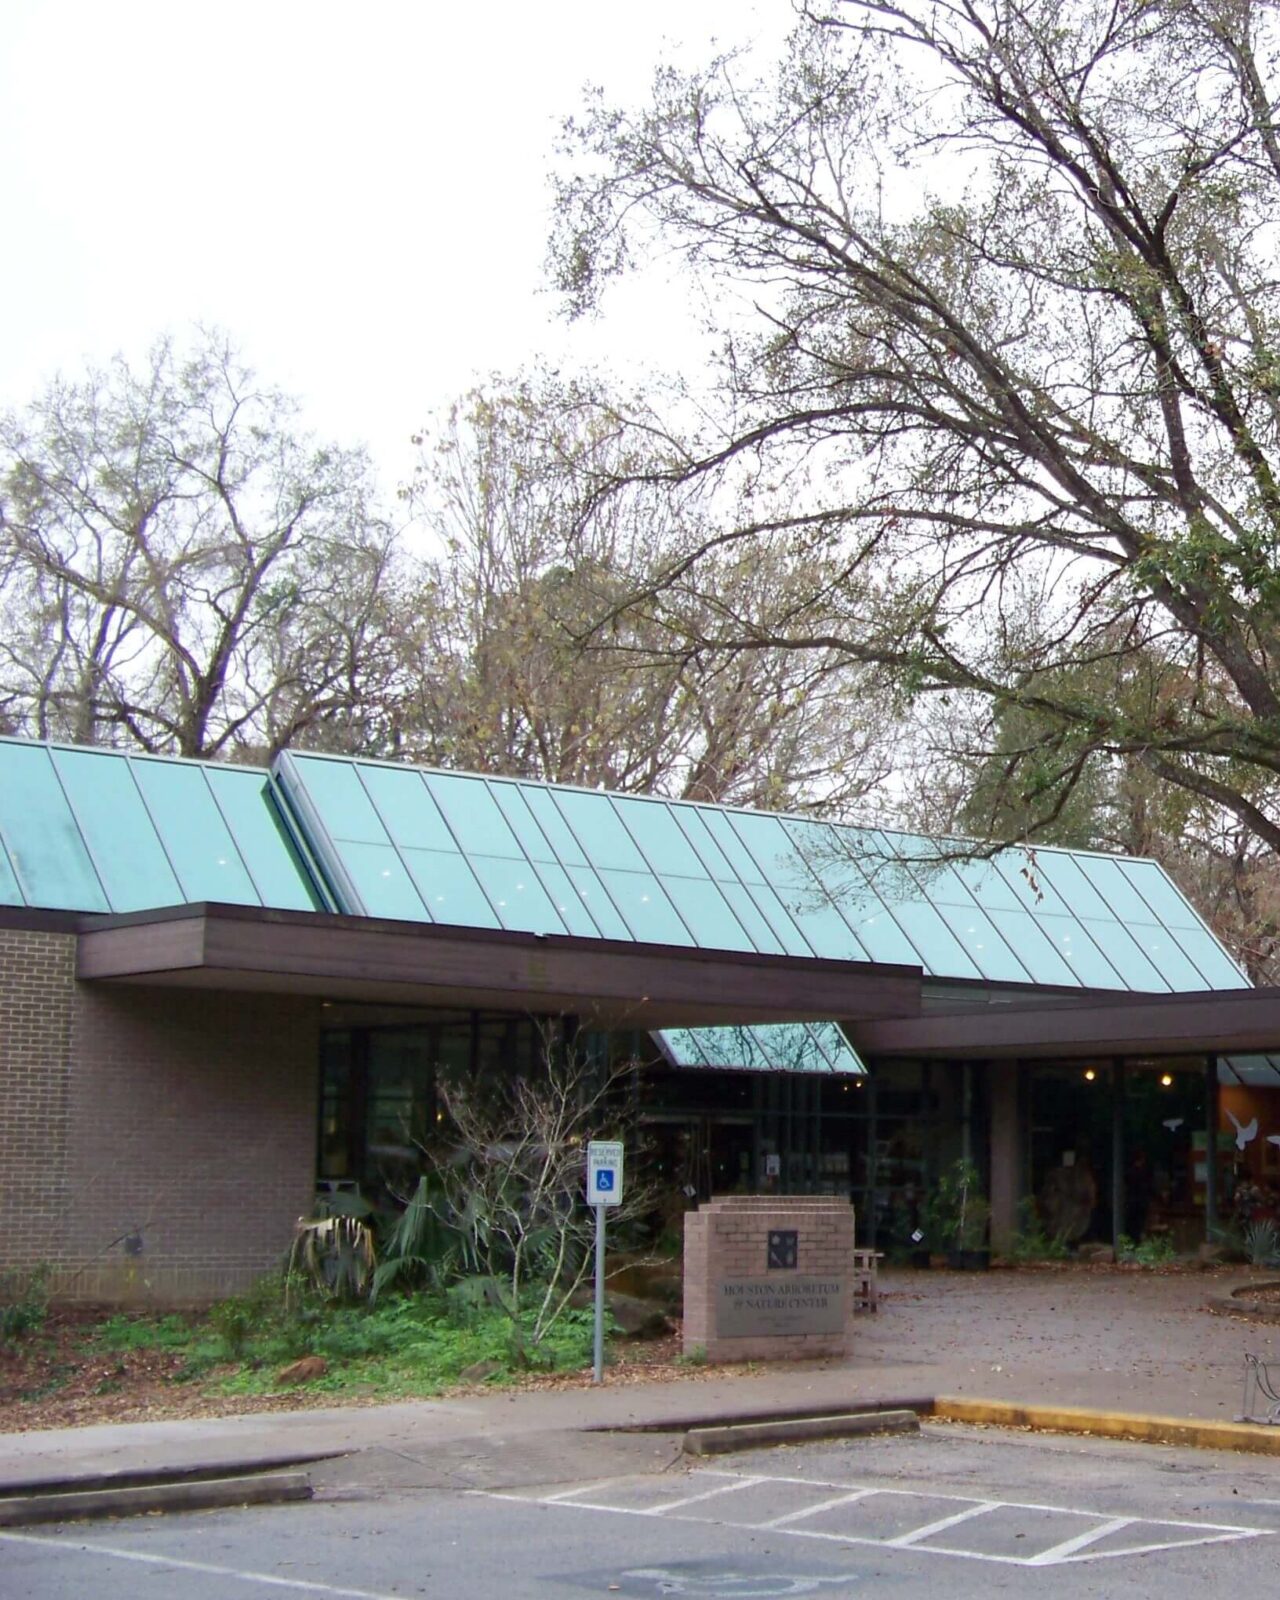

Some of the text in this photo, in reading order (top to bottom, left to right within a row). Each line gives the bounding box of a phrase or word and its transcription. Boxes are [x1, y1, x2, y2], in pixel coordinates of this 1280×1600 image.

[590, 1148, 621, 1156] RESERVED
[593, 1158, 618, 1166] PARKING
[723, 1283, 840, 1296] HOUSTON ARBORETUM
[746, 1299, 785, 1309] NATURE
[789, 1298, 828, 1309] CENTER
